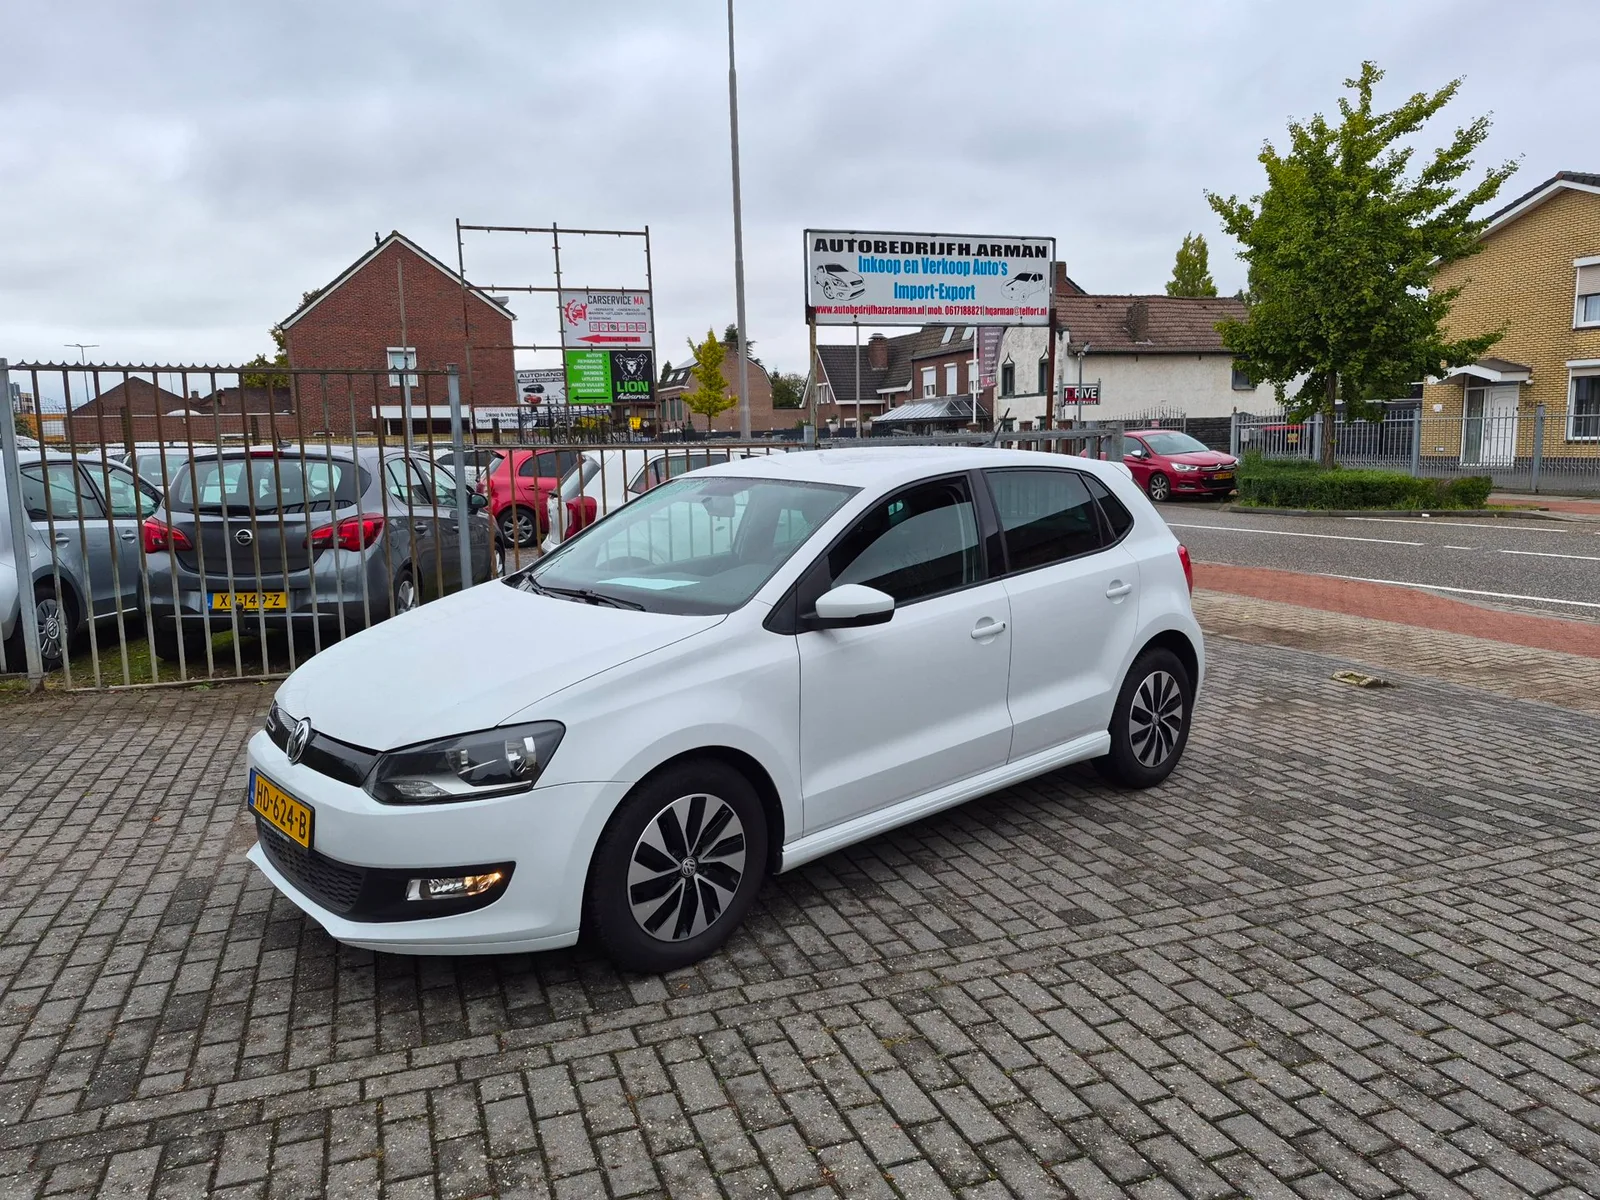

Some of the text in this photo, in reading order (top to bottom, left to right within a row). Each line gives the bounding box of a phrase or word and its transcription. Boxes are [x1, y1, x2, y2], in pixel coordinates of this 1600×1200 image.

[858, 255, 1008, 277] Inkoop en Verkoop Auto's
[894, 282, 976, 301] Import-Export
[588, 295, 644, 305] CARSERVICE MA
[928, 306, 944, 315] mob.
[617, 381, 649, 392] LION
[256, 780, 307, 840] HD-624-B
